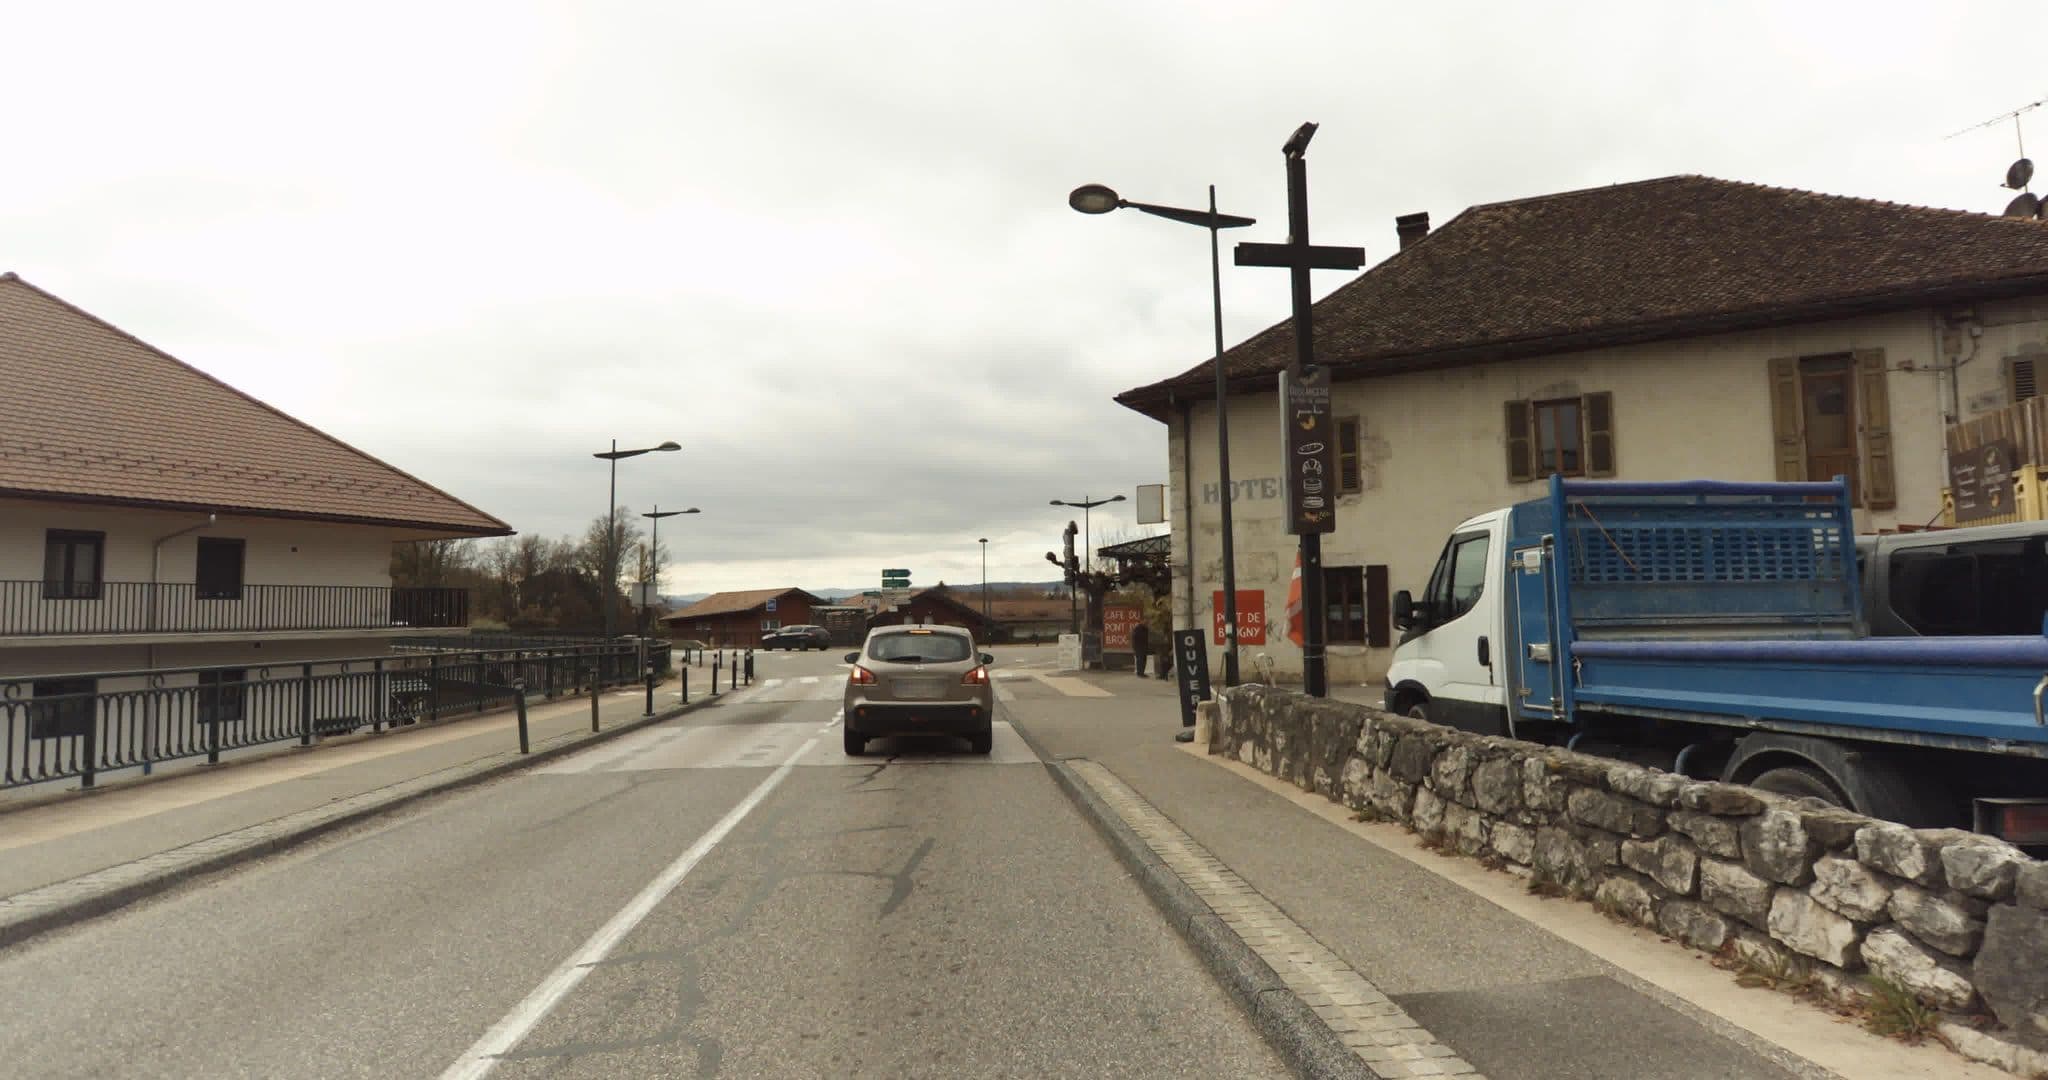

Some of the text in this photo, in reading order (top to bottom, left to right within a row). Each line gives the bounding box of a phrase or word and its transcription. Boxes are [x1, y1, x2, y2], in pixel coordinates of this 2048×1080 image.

[1216, 612, 1261, 623] PT DE
[1218, 627, 1260, 638] BGNY
[1184, 635, 1201, 710] OUVER
